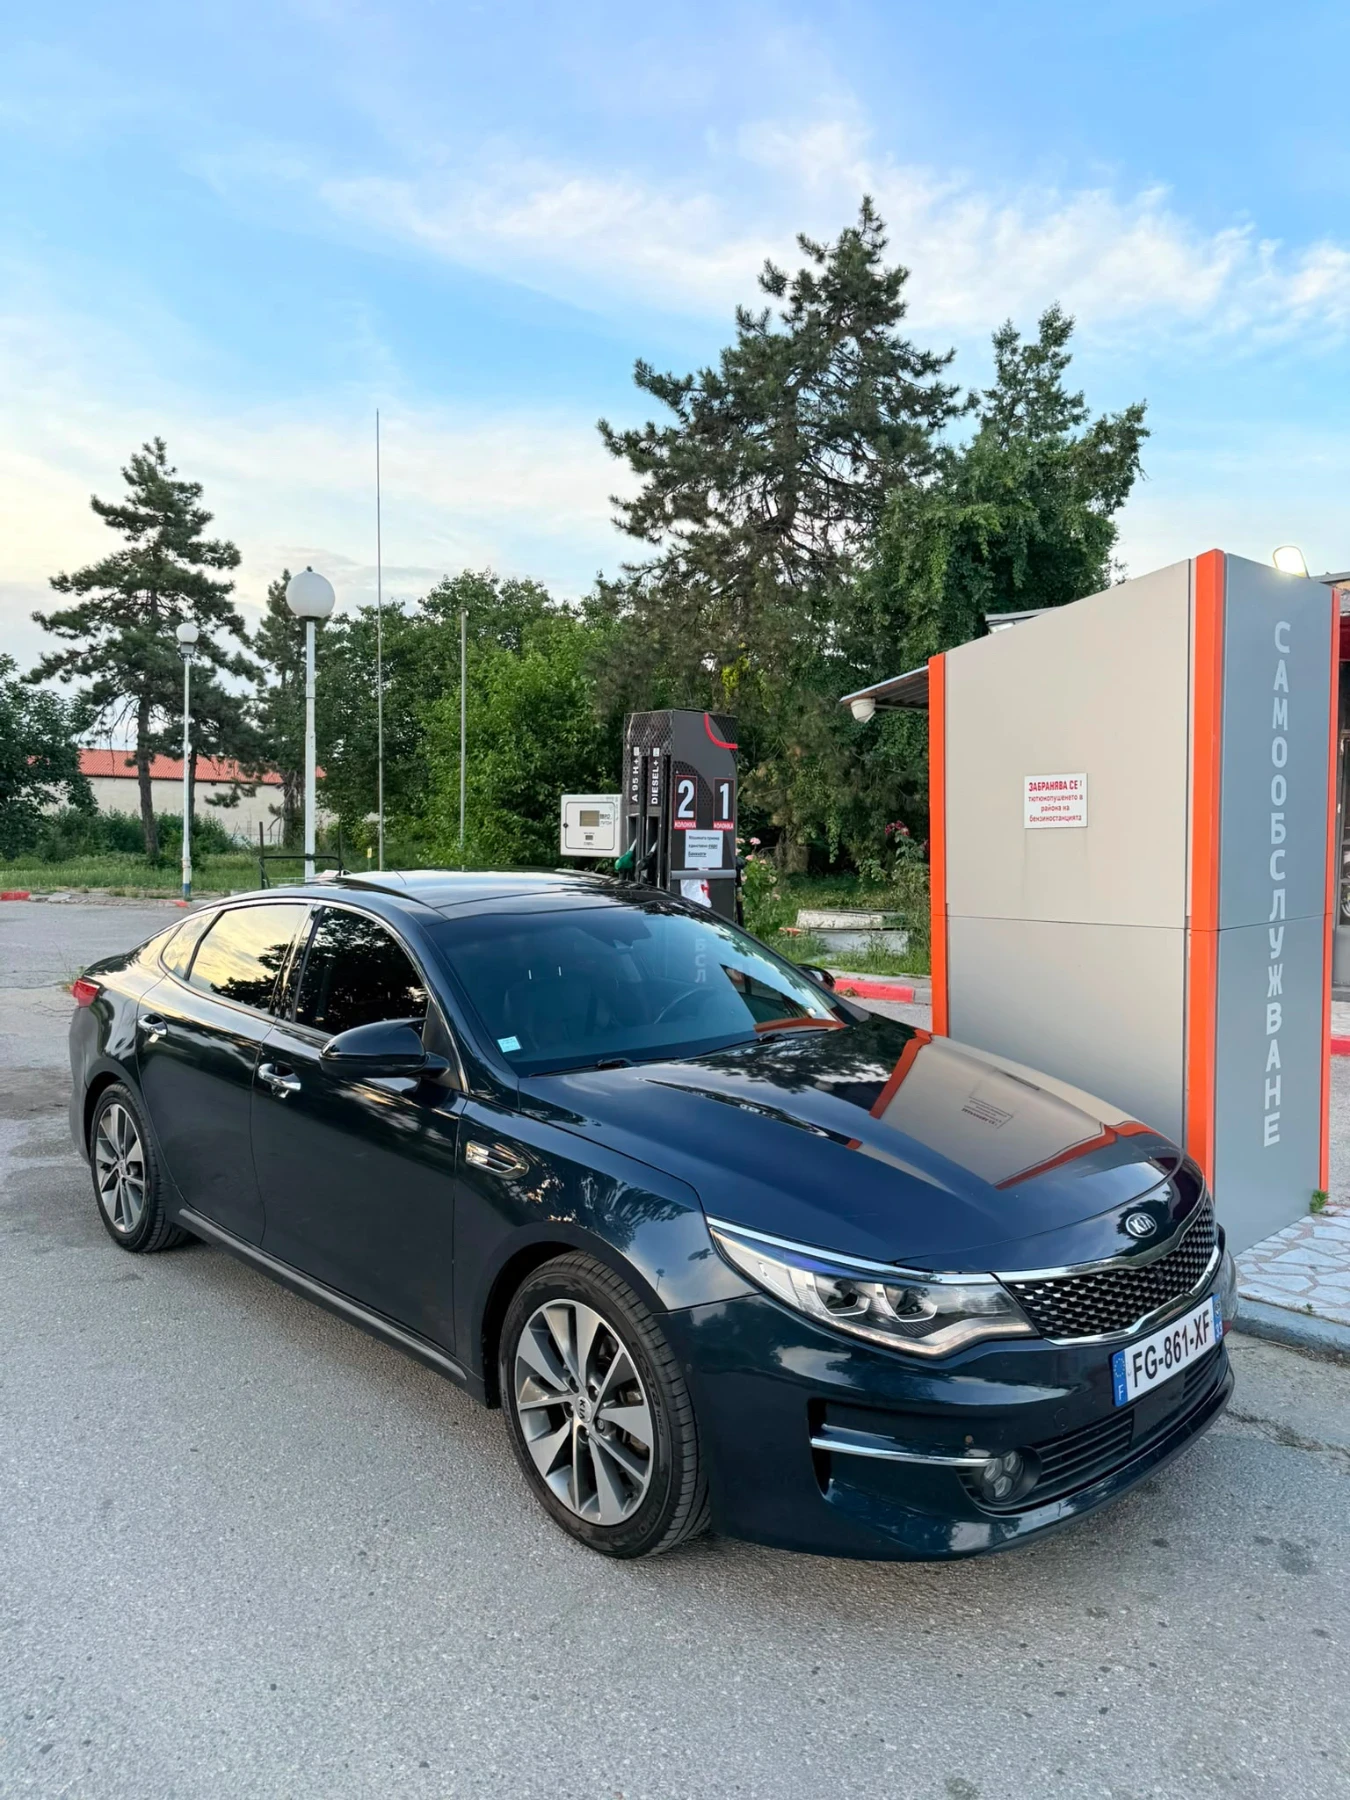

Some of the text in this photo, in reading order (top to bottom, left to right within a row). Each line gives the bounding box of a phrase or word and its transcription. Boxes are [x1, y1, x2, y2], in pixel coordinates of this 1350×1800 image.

[632, 777, 639, 791] 95
[1029, 781, 1068, 792] ЗАБРАНЯВА
[1069, 780, 1078, 790] СЕ
[678, 780, 694, 818] 2
[720, 783, 729, 820] 1
[1041, 803, 1062, 813] района
[1264, 621, 1291, 1147] САМООБСЛУЖВАНЕ
[1132, 1309, 1209, 1388] FG-861-XF
[1118, 1384, 1124, 1401] F
